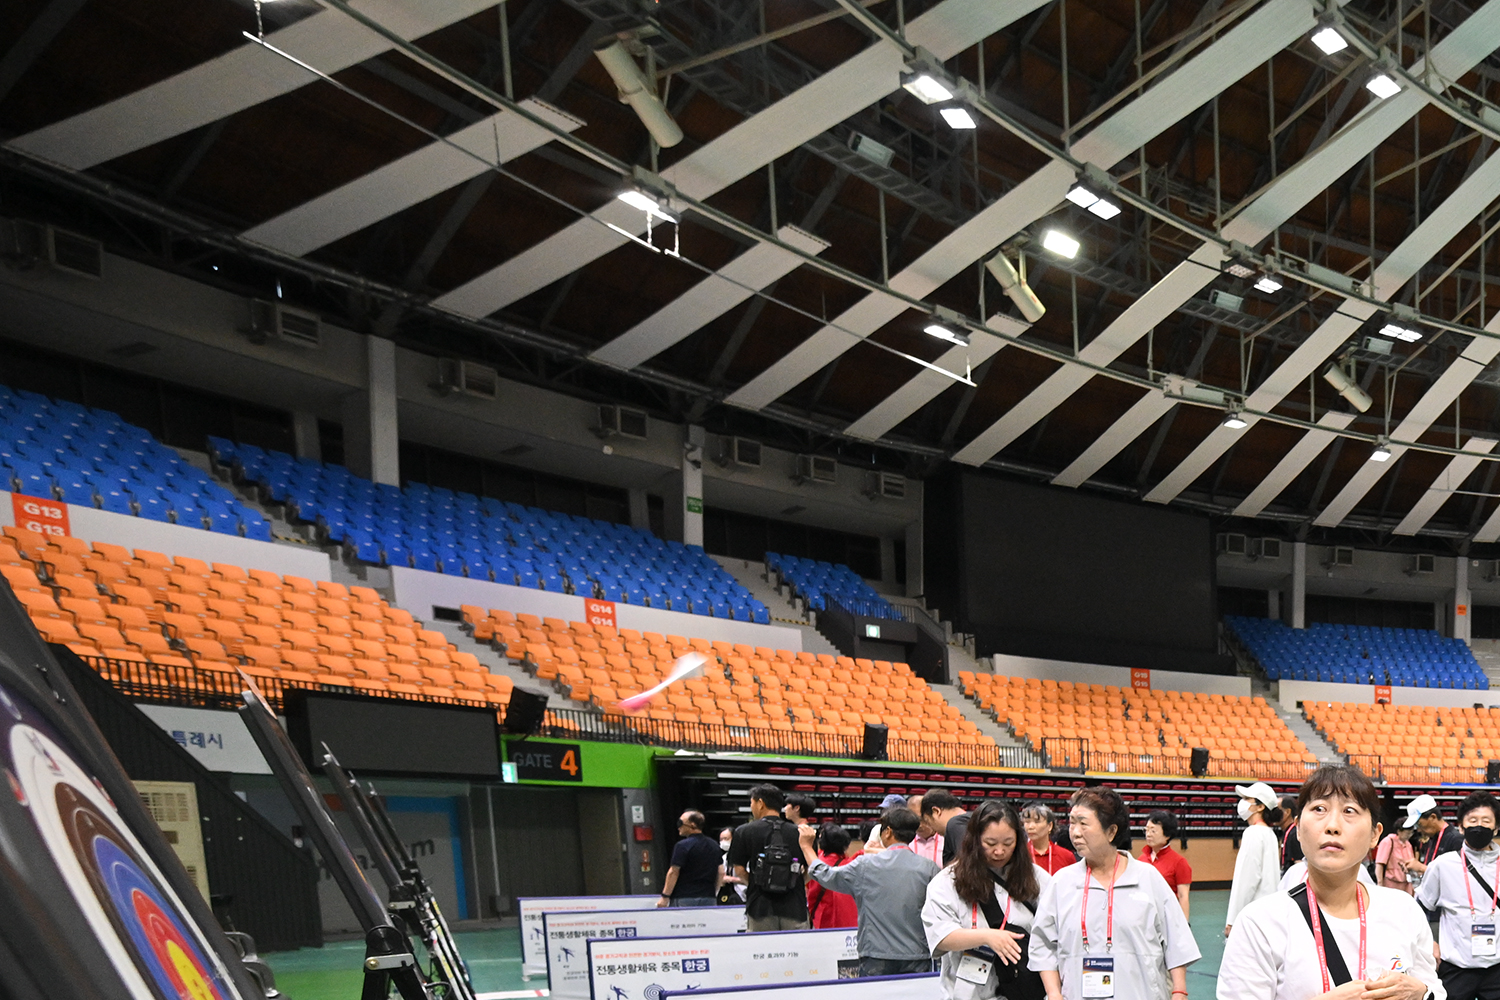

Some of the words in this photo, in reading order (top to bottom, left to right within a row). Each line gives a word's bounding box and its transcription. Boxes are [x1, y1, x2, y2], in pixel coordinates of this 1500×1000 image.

[23, 502, 62, 519] G13
[26, 521, 65, 536] G13
[590, 604, 612, 615] G14
[591, 616, 613, 627] G14
[172, 730, 224, 749] 특례시
[513, 752, 552, 768] GATE
[560, 750, 578, 776] 4
[550, 930, 596, 939] 전통생활체육
[596, 963, 657, 975] 전통생활체육
[661, 961, 681, 972] 종목
[685, 960, 706, 971] 한궁
